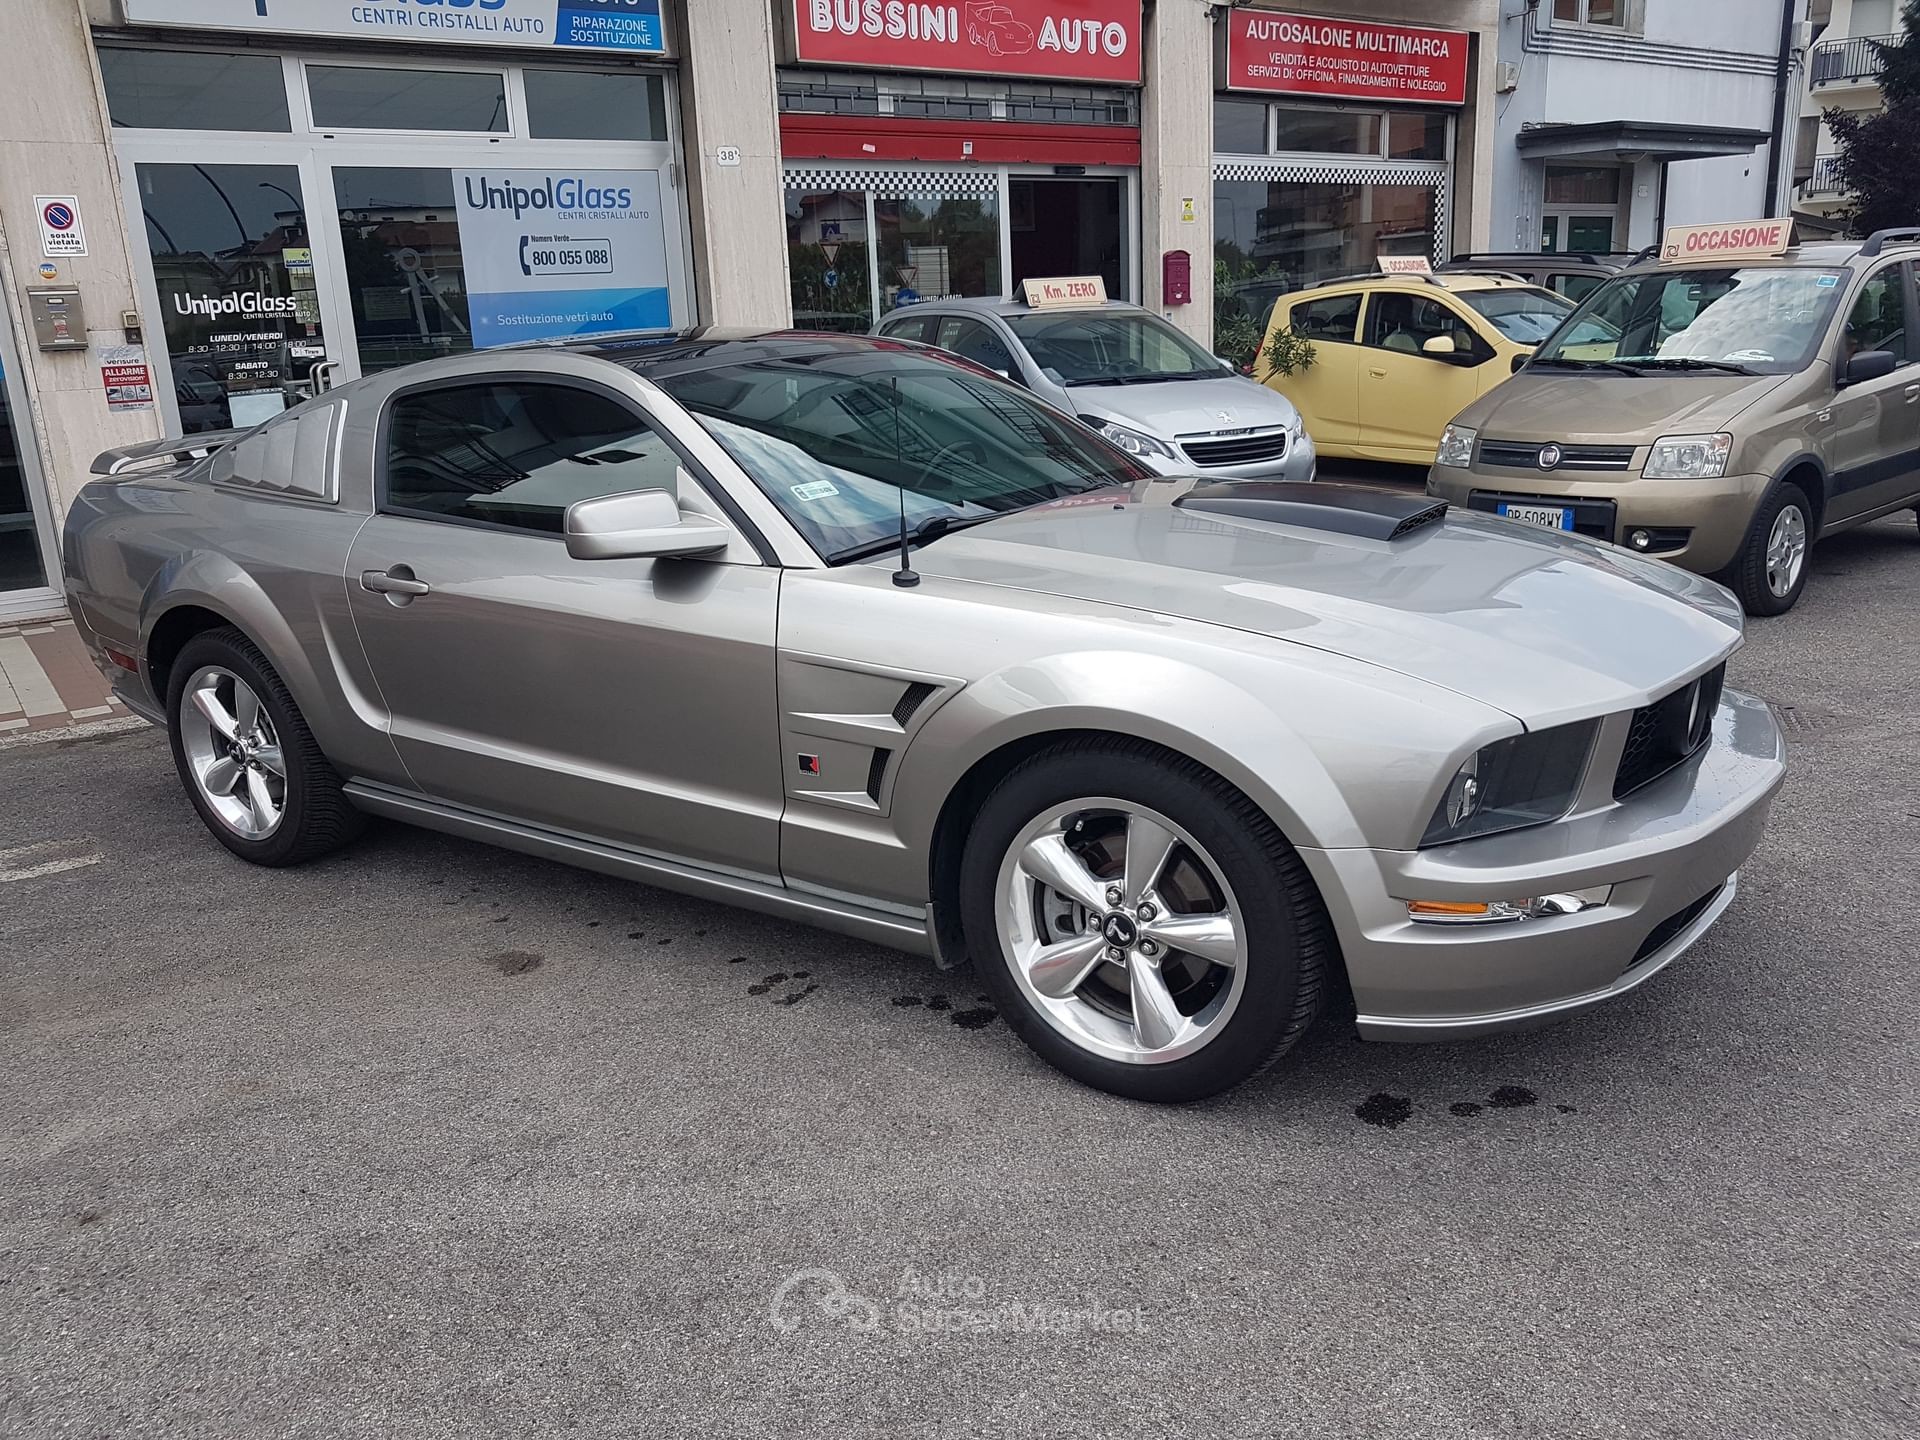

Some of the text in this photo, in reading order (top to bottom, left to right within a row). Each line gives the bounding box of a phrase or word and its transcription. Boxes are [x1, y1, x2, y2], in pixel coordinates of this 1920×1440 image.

[352, 7, 544, 34] CENTRI CRISTALLI AUTO
[572, 16, 648, 32] RIPARAZIONE
[810, 0, 1127, 57] BUSSINI AUTO
[570, 30, 652, 45] SOSTITUZIONE
[1246, 19, 1449, 58] AUTOSALONE MULTIMARCA
[1269, 52, 1430, 77] VENDITA E ACQUISTO DI AUTOVETTURE
[1247, 65, 1447, 92] SERVIZI DI: OFFICINA, FINANZIAMENTI E NOLEGGIO
[465, 176, 632, 220] UnipolGlass
[558, 211, 649, 220] CENTRI CRISTALLI AUTO
[1686, 226, 1781, 252] OCCASIONE
[532, 250, 608, 266] 800 055 088
[1043, 283, 1097, 299] Km. ZERO
[174, 291, 297, 320] UnipolGlass
[497, 312, 614, 326] Sostituzione vetri auto
[253, 342, 276, 350] 14:00
[284, 340, 307, 348] 18:00
[105, 367, 146, 376] ALLARME
[235, 362, 269, 370] SABATO
